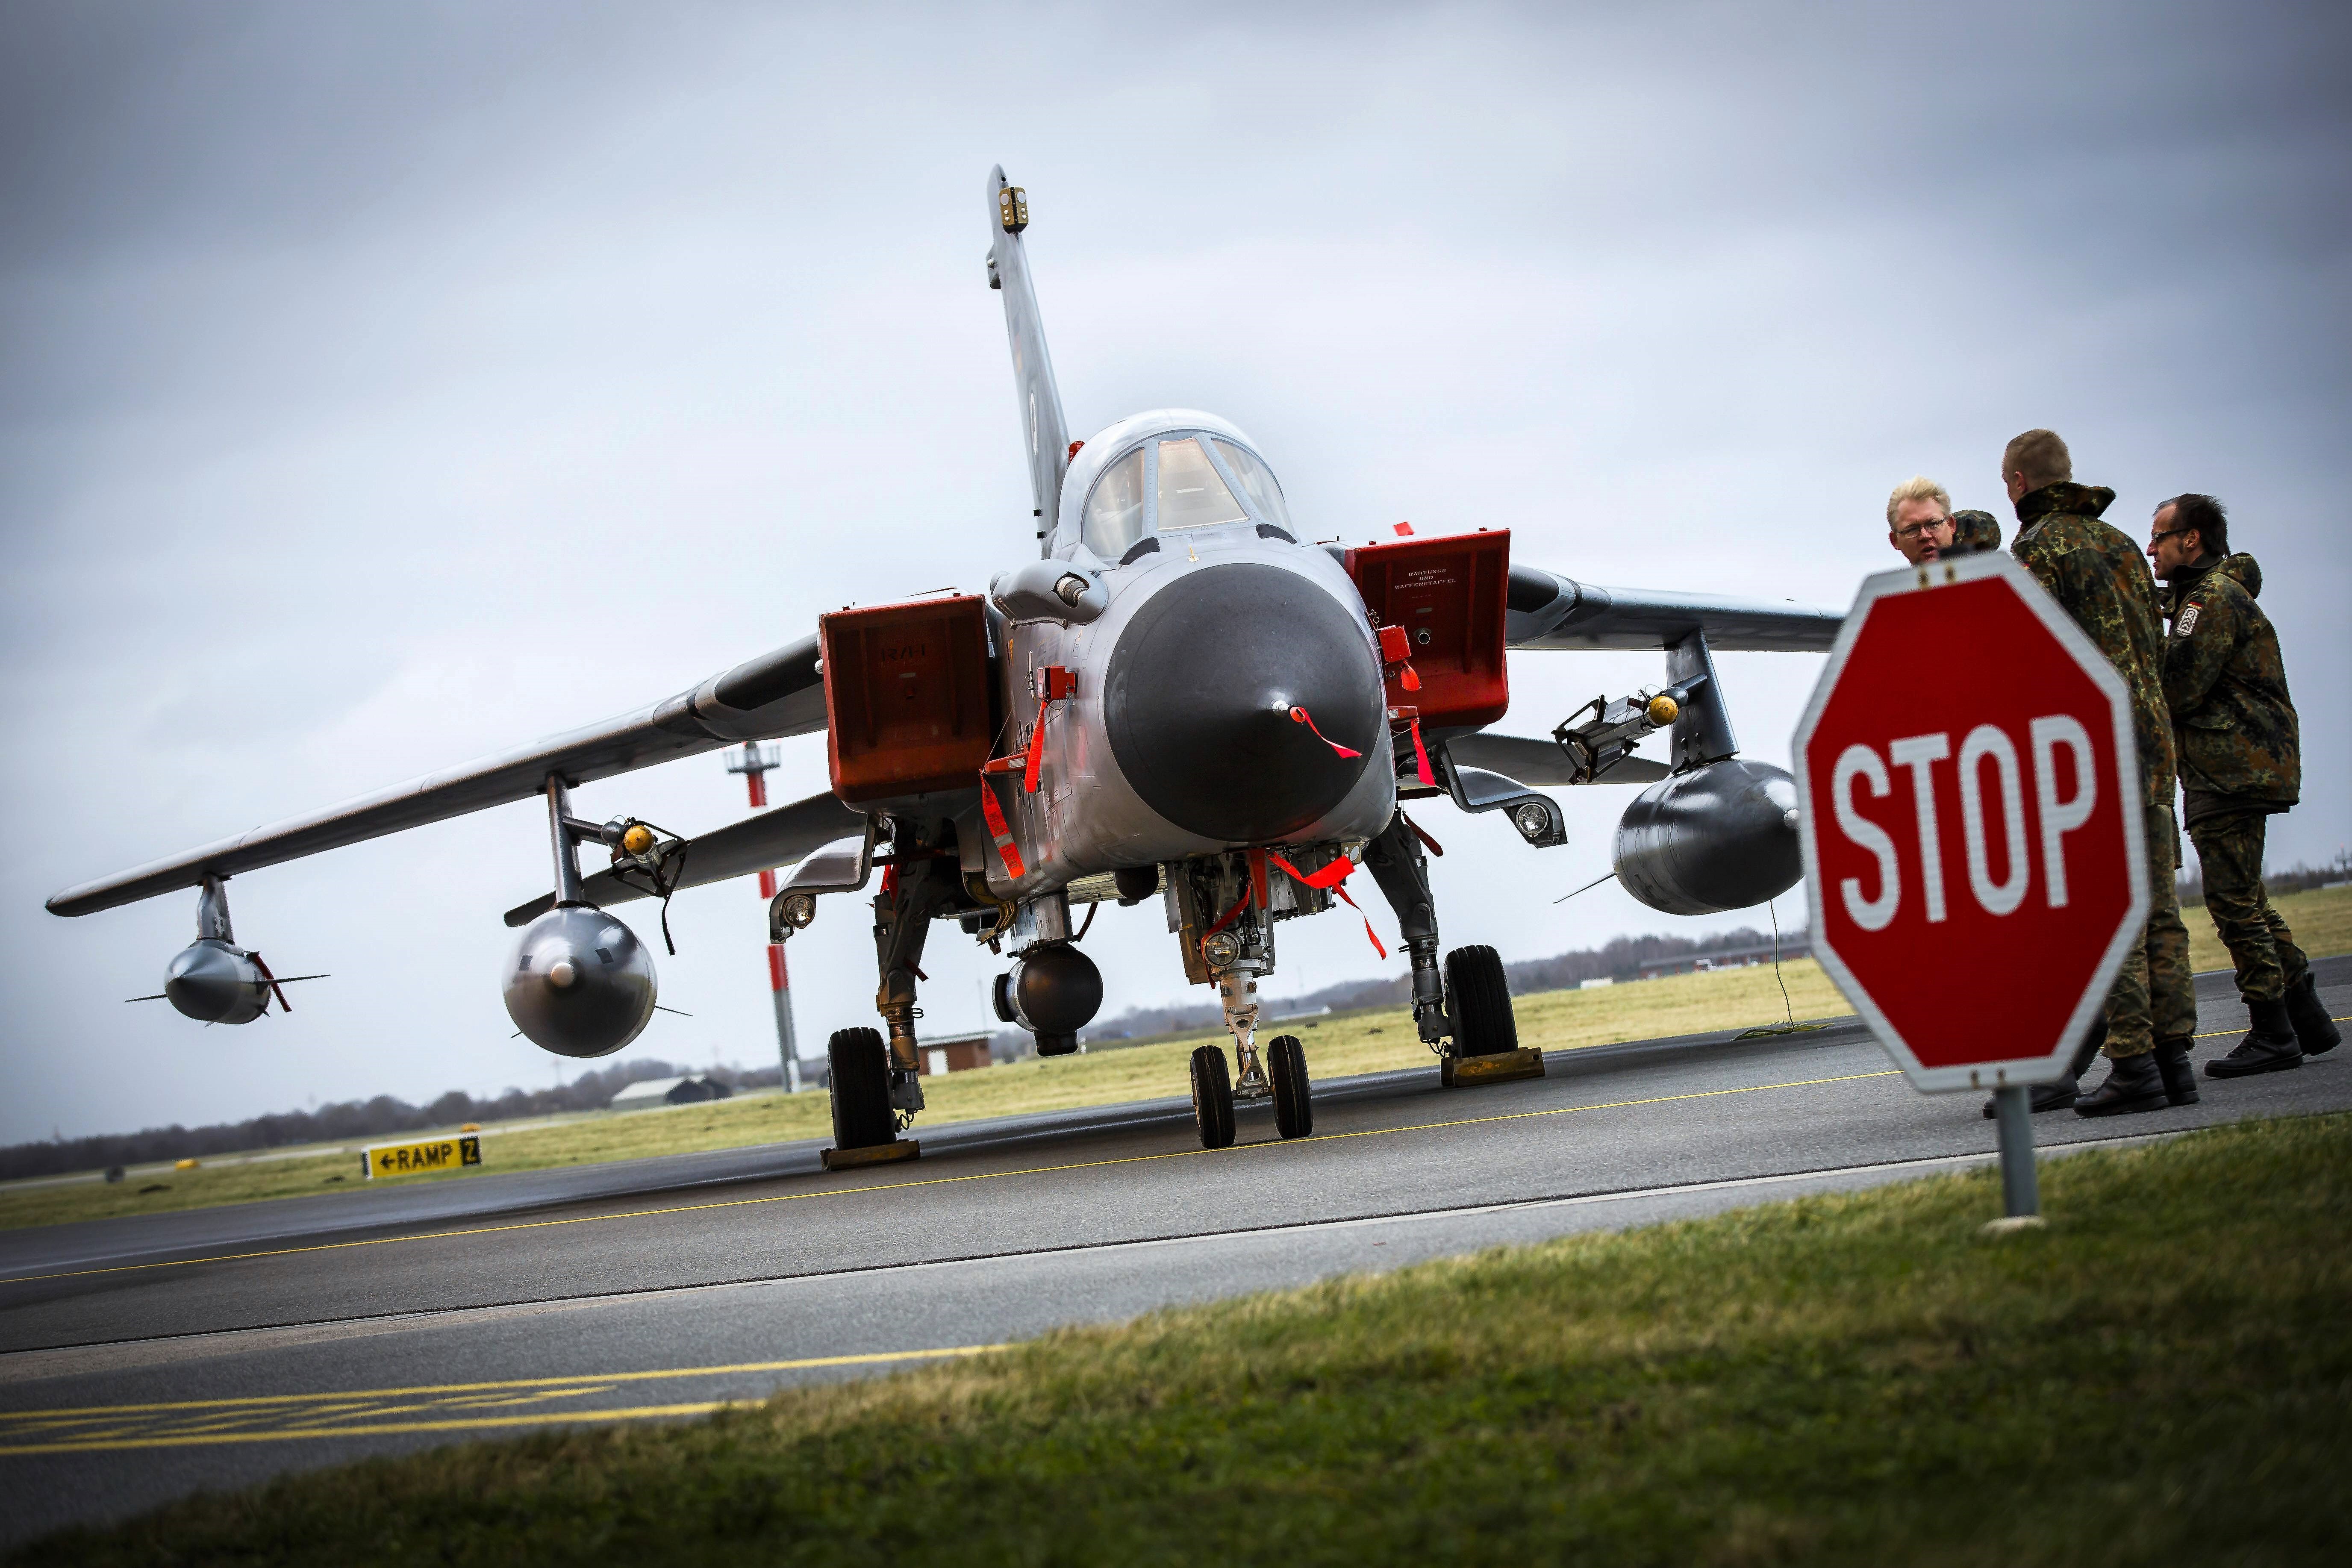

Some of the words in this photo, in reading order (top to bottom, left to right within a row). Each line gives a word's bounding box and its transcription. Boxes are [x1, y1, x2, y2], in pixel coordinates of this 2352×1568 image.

[1833, 715, 2097, 931] STOP
[397, 1143, 453, 1170] RAMP
[464, 1140, 477, 1162] Z
